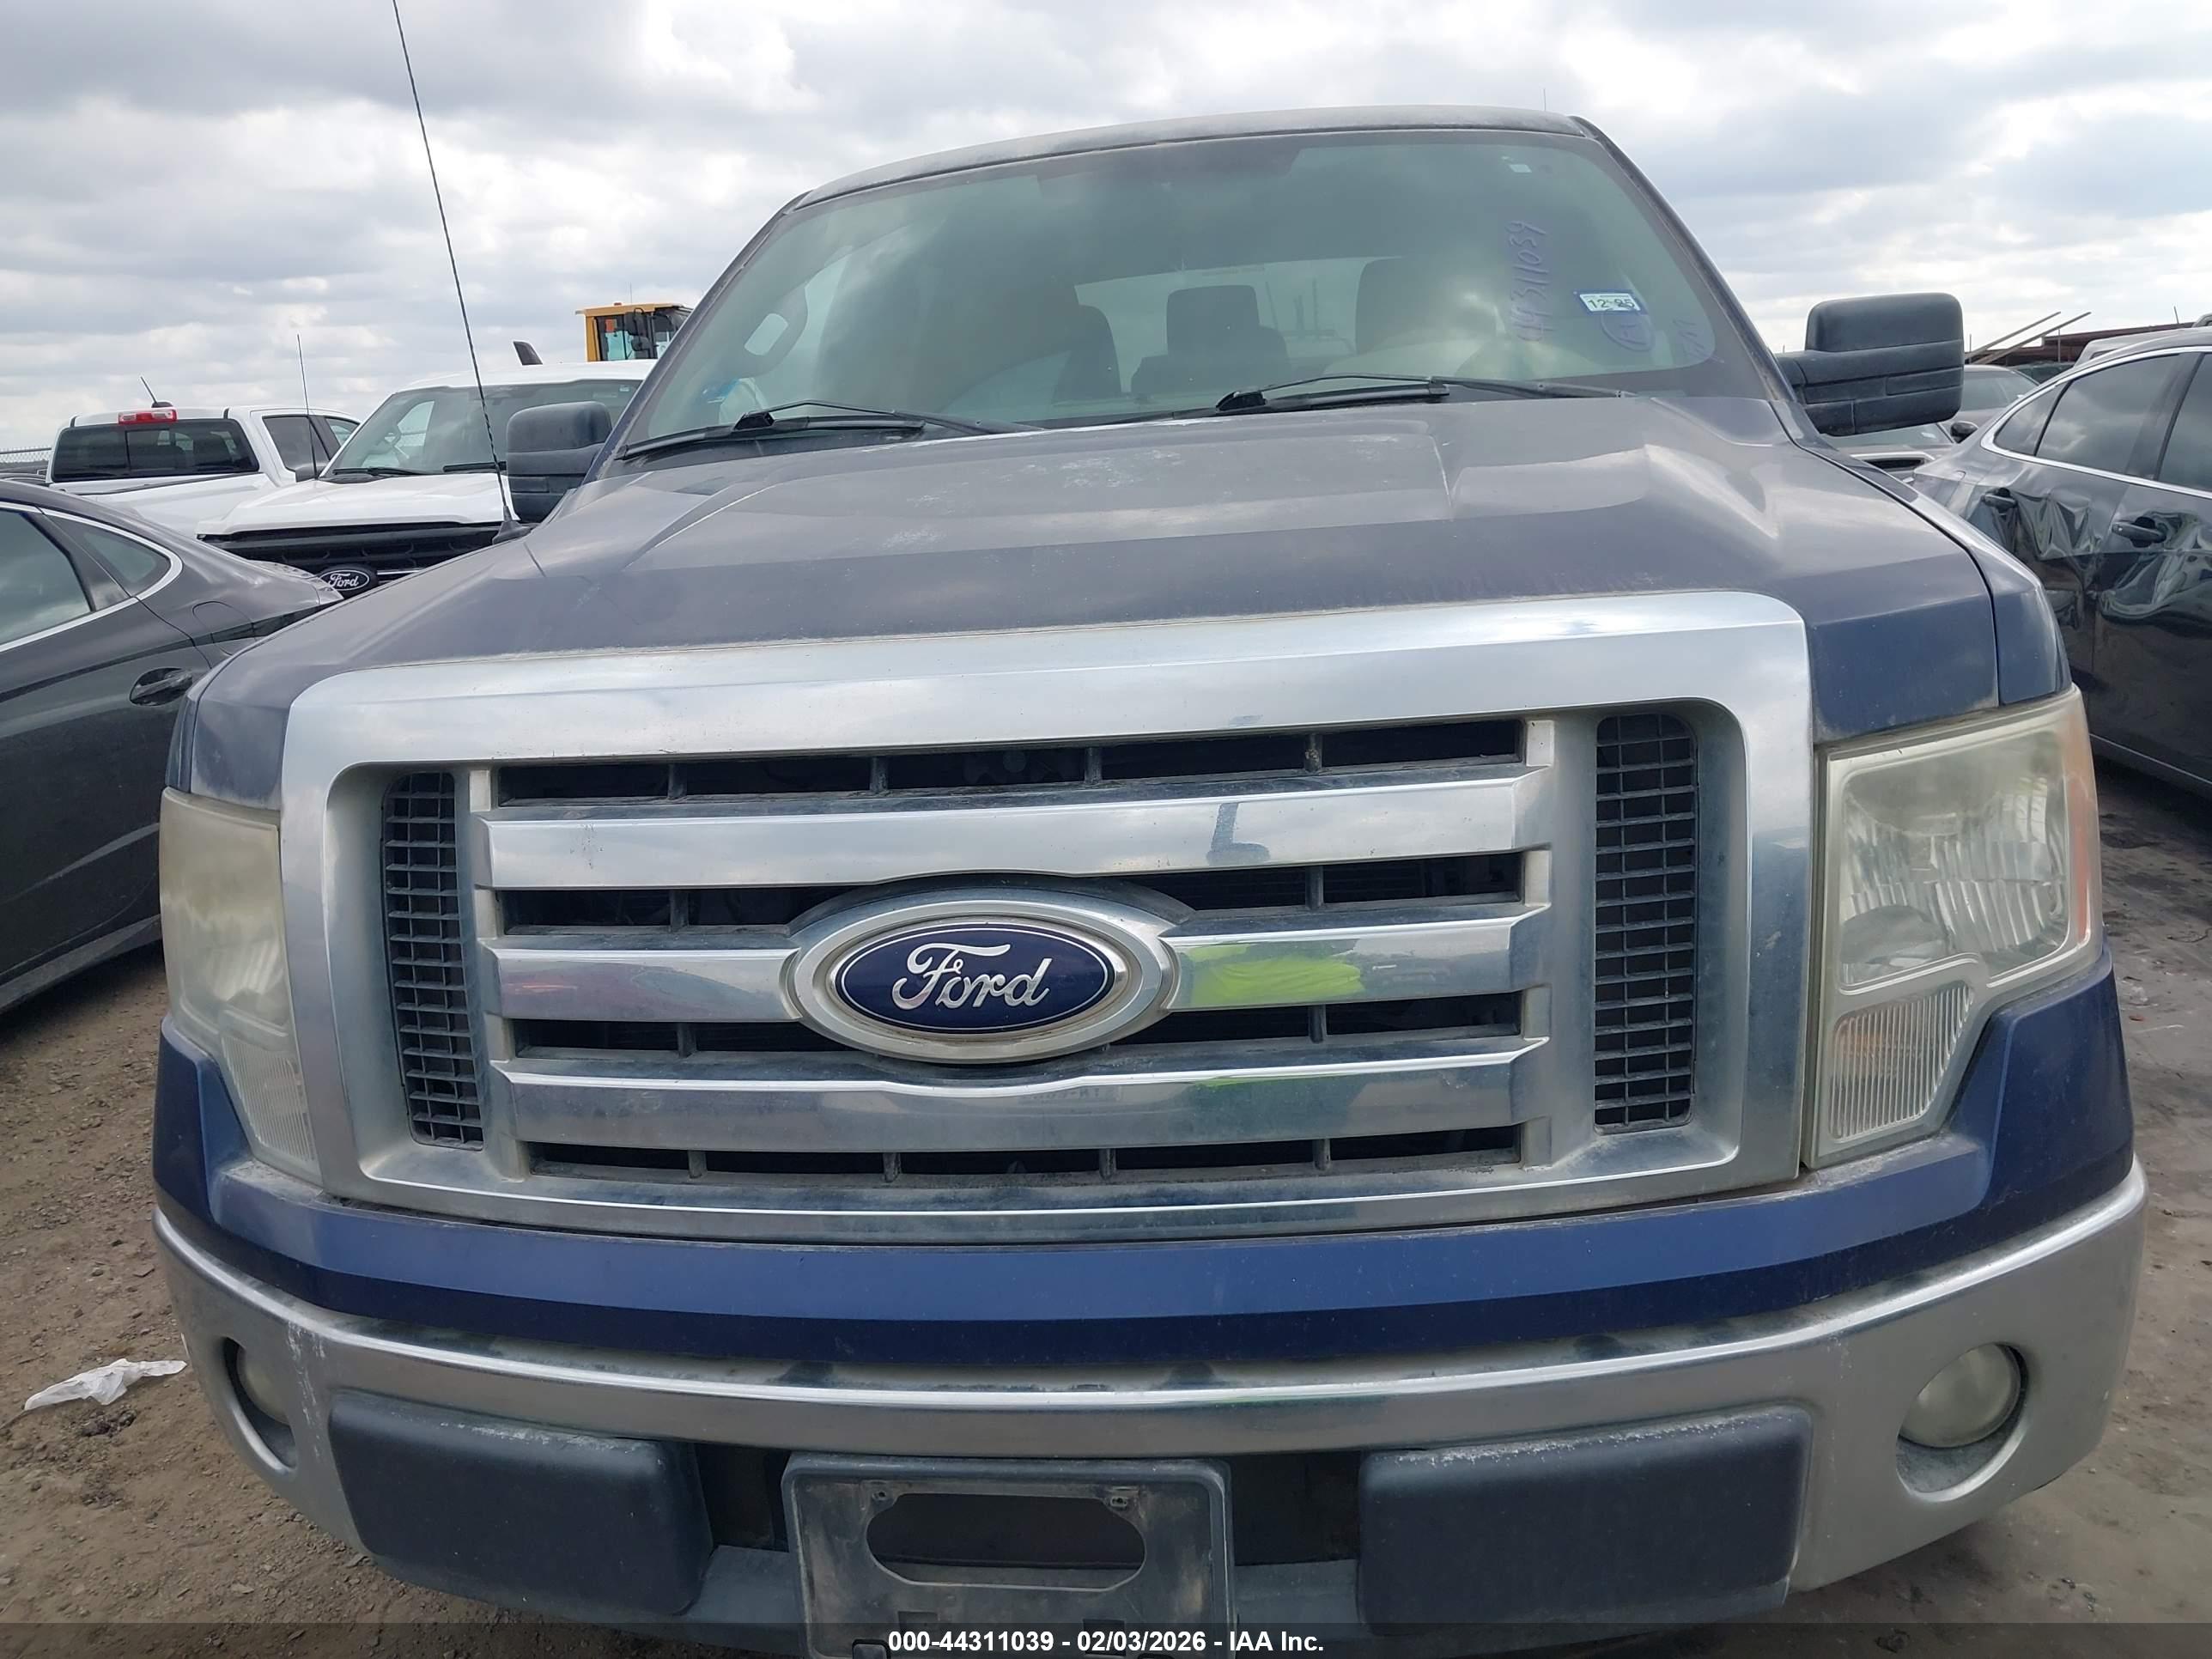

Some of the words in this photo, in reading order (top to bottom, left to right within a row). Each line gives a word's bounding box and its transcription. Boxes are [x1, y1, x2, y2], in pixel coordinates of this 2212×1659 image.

[1588, 298, 1610, 308] 12
[327, 573, 360, 587] Ford
[891, 942, 1053, 1010] Ford
